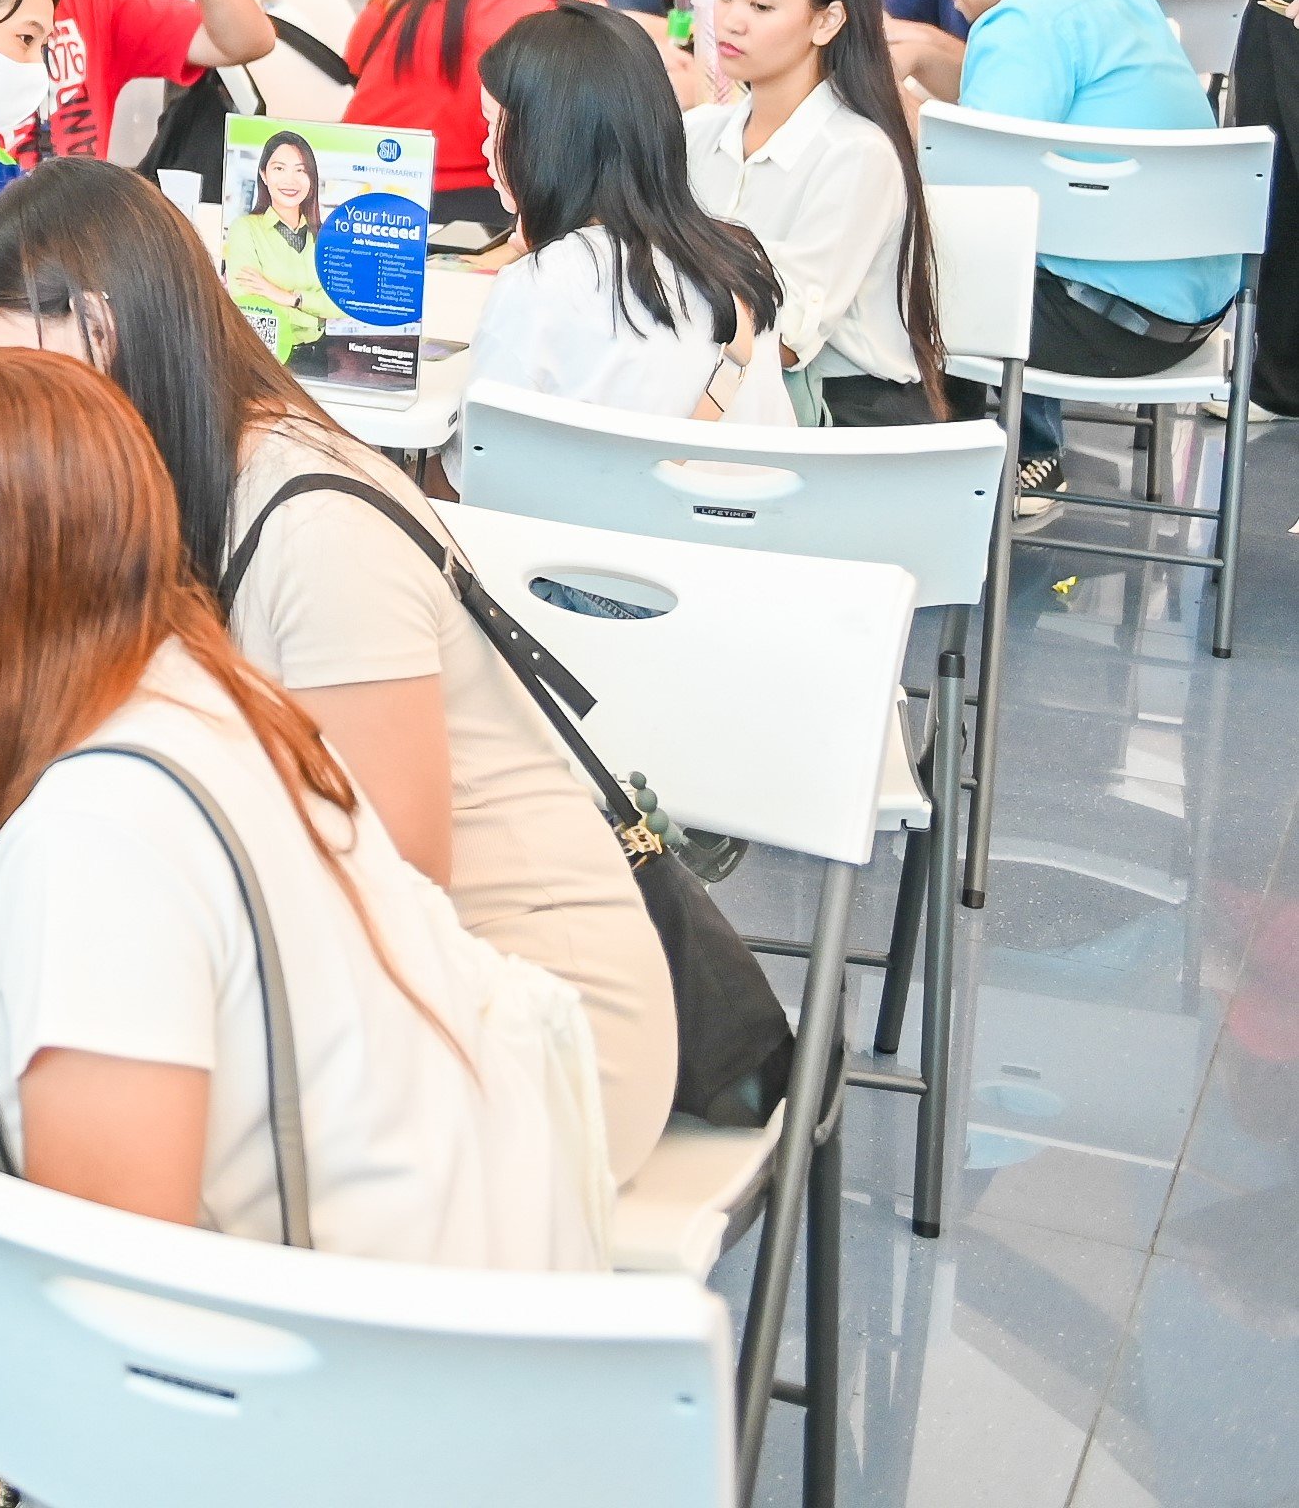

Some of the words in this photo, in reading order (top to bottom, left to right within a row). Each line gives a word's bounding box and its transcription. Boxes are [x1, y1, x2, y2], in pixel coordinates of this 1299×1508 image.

[345, 205, 378, 222] Your
[381, 211, 411, 227] turn
[335, 219, 349, 232] to
[352, 223, 420, 240] succeed
[700, 507, 748, 518] LIFETIME
